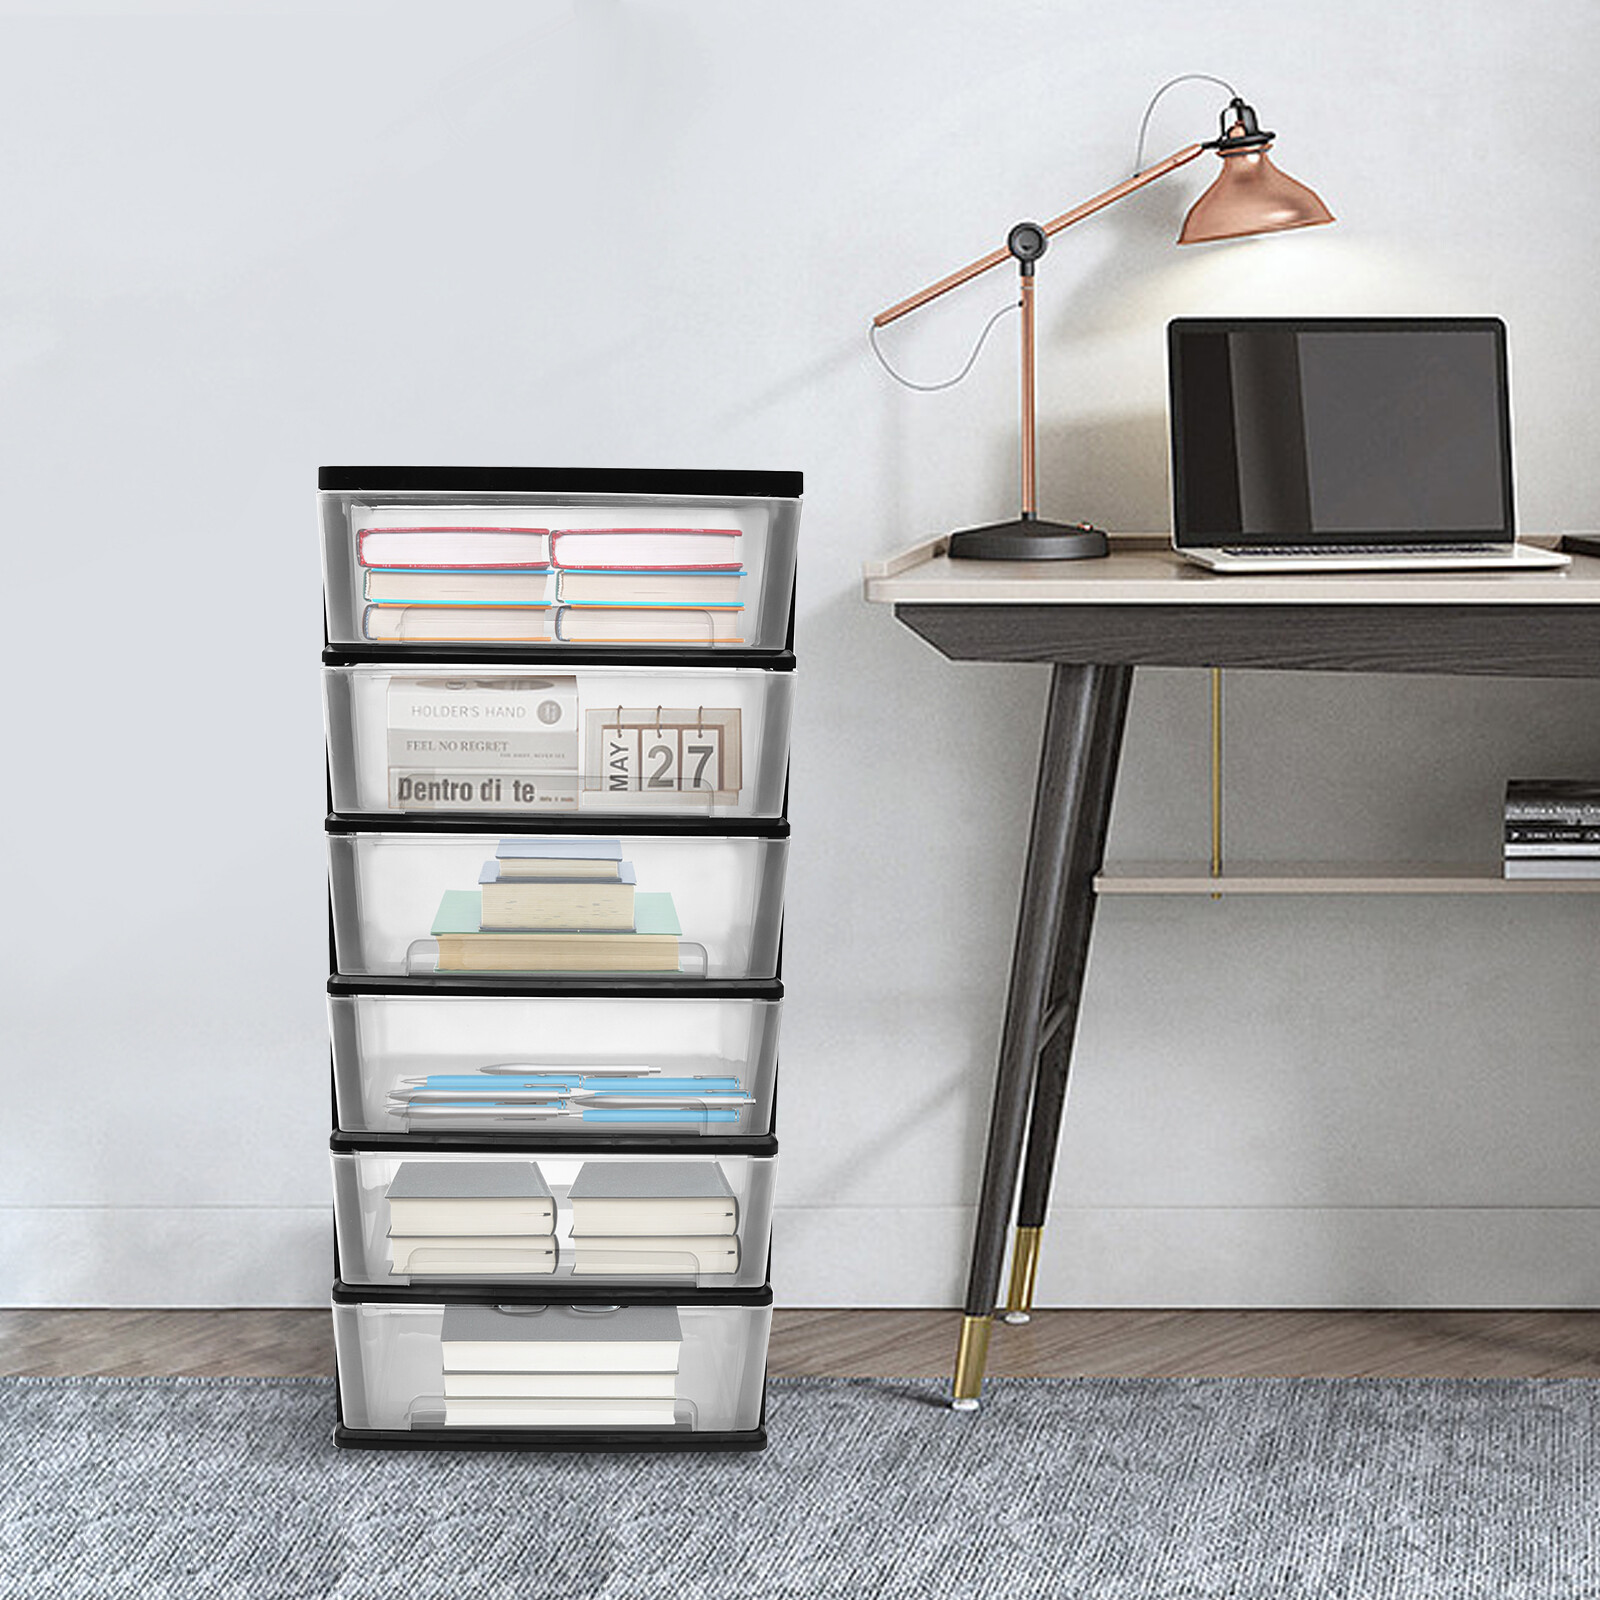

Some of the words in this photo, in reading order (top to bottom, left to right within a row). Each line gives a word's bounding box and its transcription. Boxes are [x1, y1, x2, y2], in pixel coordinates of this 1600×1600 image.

[485, 706, 527, 719] HAND
[406, 740, 436, 752] FEEL
[439, 740, 458, 752] NO
[460, 740, 510, 753] REGRET
[609, 742, 629, 791] MAY
[398, 777, 473, 801] Dentro
[480, 777, 502, 802] di
[512, 779, 535, 803] te
